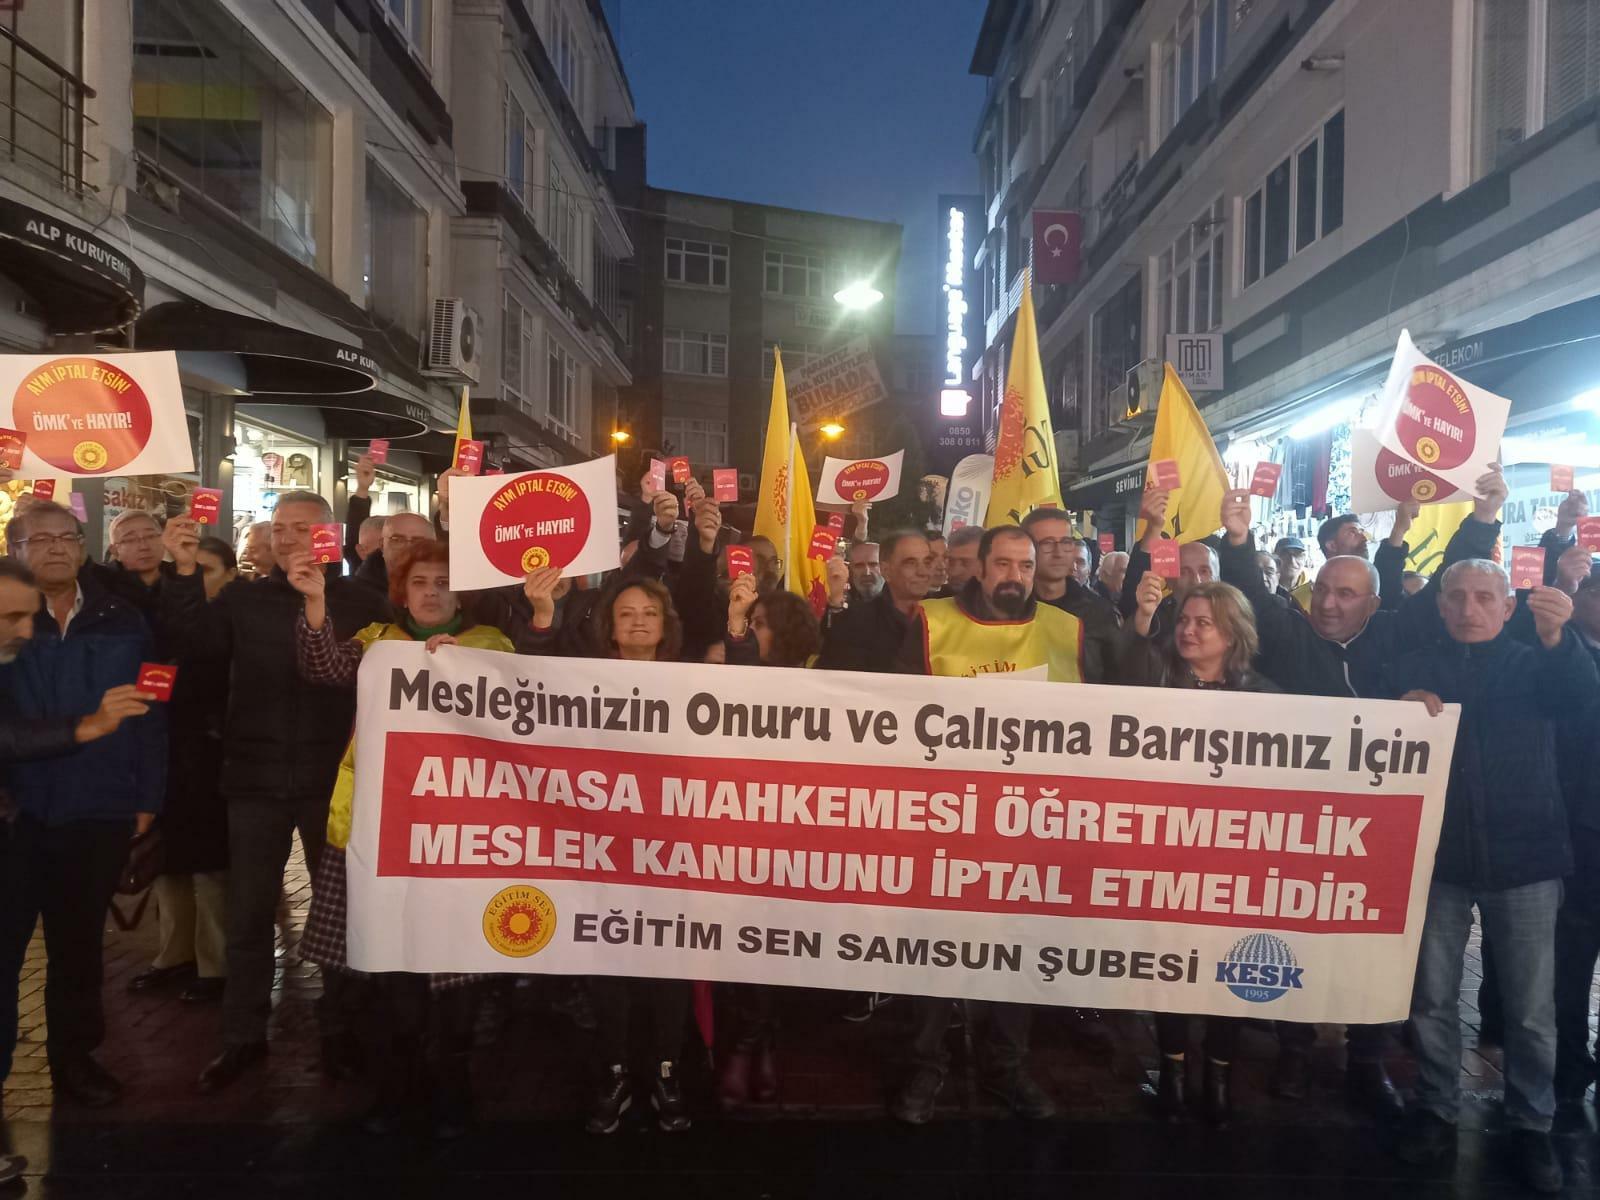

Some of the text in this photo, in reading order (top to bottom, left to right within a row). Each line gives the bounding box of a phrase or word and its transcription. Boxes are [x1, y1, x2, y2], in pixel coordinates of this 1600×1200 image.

[26, 220, 61, 241] ALP
[336, 349, 357, 362] ALP
[26, 364, 131, 396] AYM İPTAL ETSİN!
[87, 411, 133, 429] HAYIR!
[1433, 416, 1464, 443] HAYIR!
[493, 479, 578, 511] AYM İPTAL ETSİN!
[536, 517, 575, 536] HAYIR!
[389, 667, 1431, 787] Mesleğimizin Onuru ve Çalışma Barışımız İçin
[410, 756, 1372, 858] ANAYASA MAHKEMESİ ÖĞRETMENLİK
[408, 823, 1381, 921] MESLEK KANUNUNU İPTAL ETMELİDİR.
[573, 909, 723, 951] EĞİTİM
[737, 926, 822, 959] SEN
[837, 933, 1022, 972] SAMSUN
[1037, 946, 1199, 984] ŞUBESİ
[1215, 961, 1304, 989] KESK
[1245, 989, 1270, 1000] 1995
